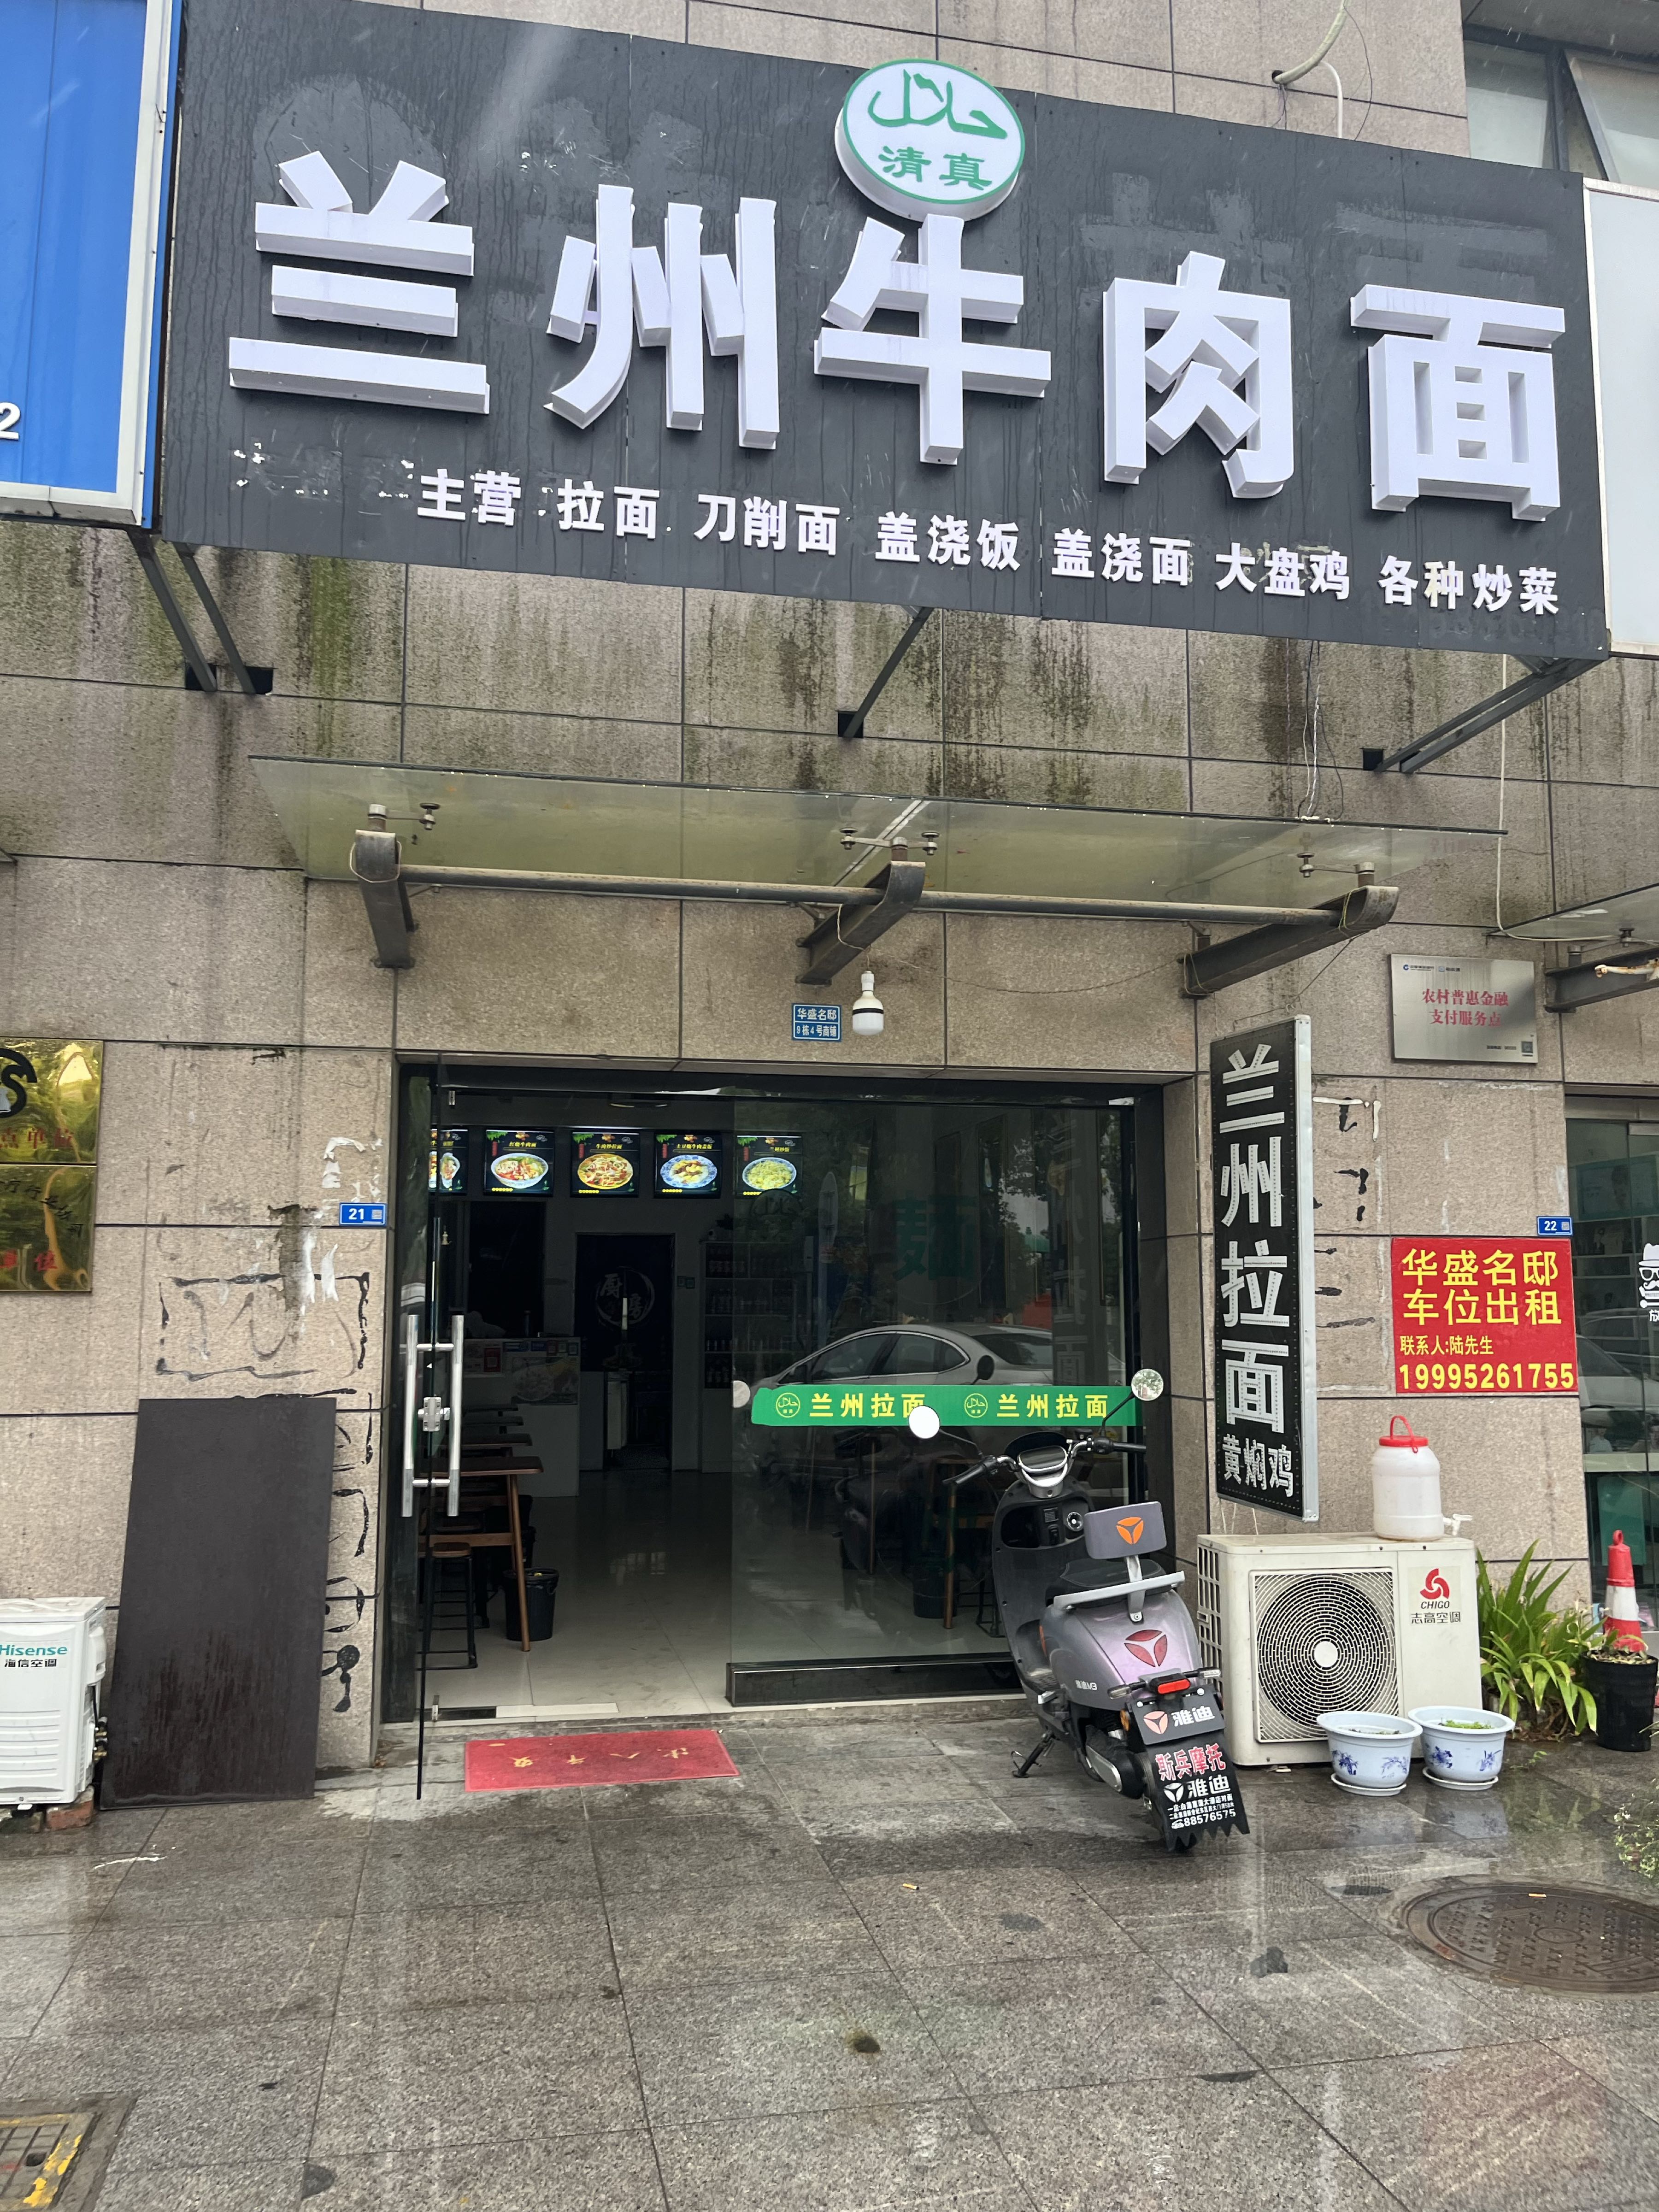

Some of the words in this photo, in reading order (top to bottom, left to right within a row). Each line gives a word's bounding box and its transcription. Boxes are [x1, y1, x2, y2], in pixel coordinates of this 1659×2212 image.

[878, 145, 992, 190] 清真
[229, 150, 1565, 521] 兰州牛肉面
[417, 468, 521, 527] 主营
[557, 481, 659, 540] 拉面
[694, 493, 840, 555] 刀削面
[875, 512, 1021, 572] 盖浇饭
[1051, 528, 1193, 587] 盖浇面
[1215, 541, 1351, 600] 大盘鸡
[1378, 554, 1559, 615] 各种炒菜
[1422, 988, 1509, 1006] 农村普惠金融
[797, 1008, 837, 1021] 华盛名邸
[1430, 1009, 1501, 1028] 支付服务点
[348, 1208, 364, 1220] 21
[1544, 1220, 1557, 1231] 22
[1219, 1043, 1290, 1434] 兰州拉面
[1401, 1248, 1559, 1287] 华盛名邸
[1403, 1288, 1562, 1326] 车位出租
[1400, 1335, 1494, 1356] 联系人:陆先生
[1399, 1362, 1574, 1389] 19995261755
[809, 1393, 925, 1418] 兰州拉面
[996, 1394, 1108, 1418] 兰州拉面
[1221, 1433, 1294, 1498] 黄焖鸡
[1420, 1601, 1450, 1609] CHIGO
[1411, 1611, 1461, 1624] 志高空调
[0, 1644, 67, 1656] Hisense
[4, 1659, 57, 1667] 海信空调
[1171, 1705, 1215, 1727] 雅迪
[1155, 1742, 1226, 1781] 斯兵摩托
[1187, 1774, 1231, 1799] 雅迪
[1183, 1808, 1236, 1827] 88576575
